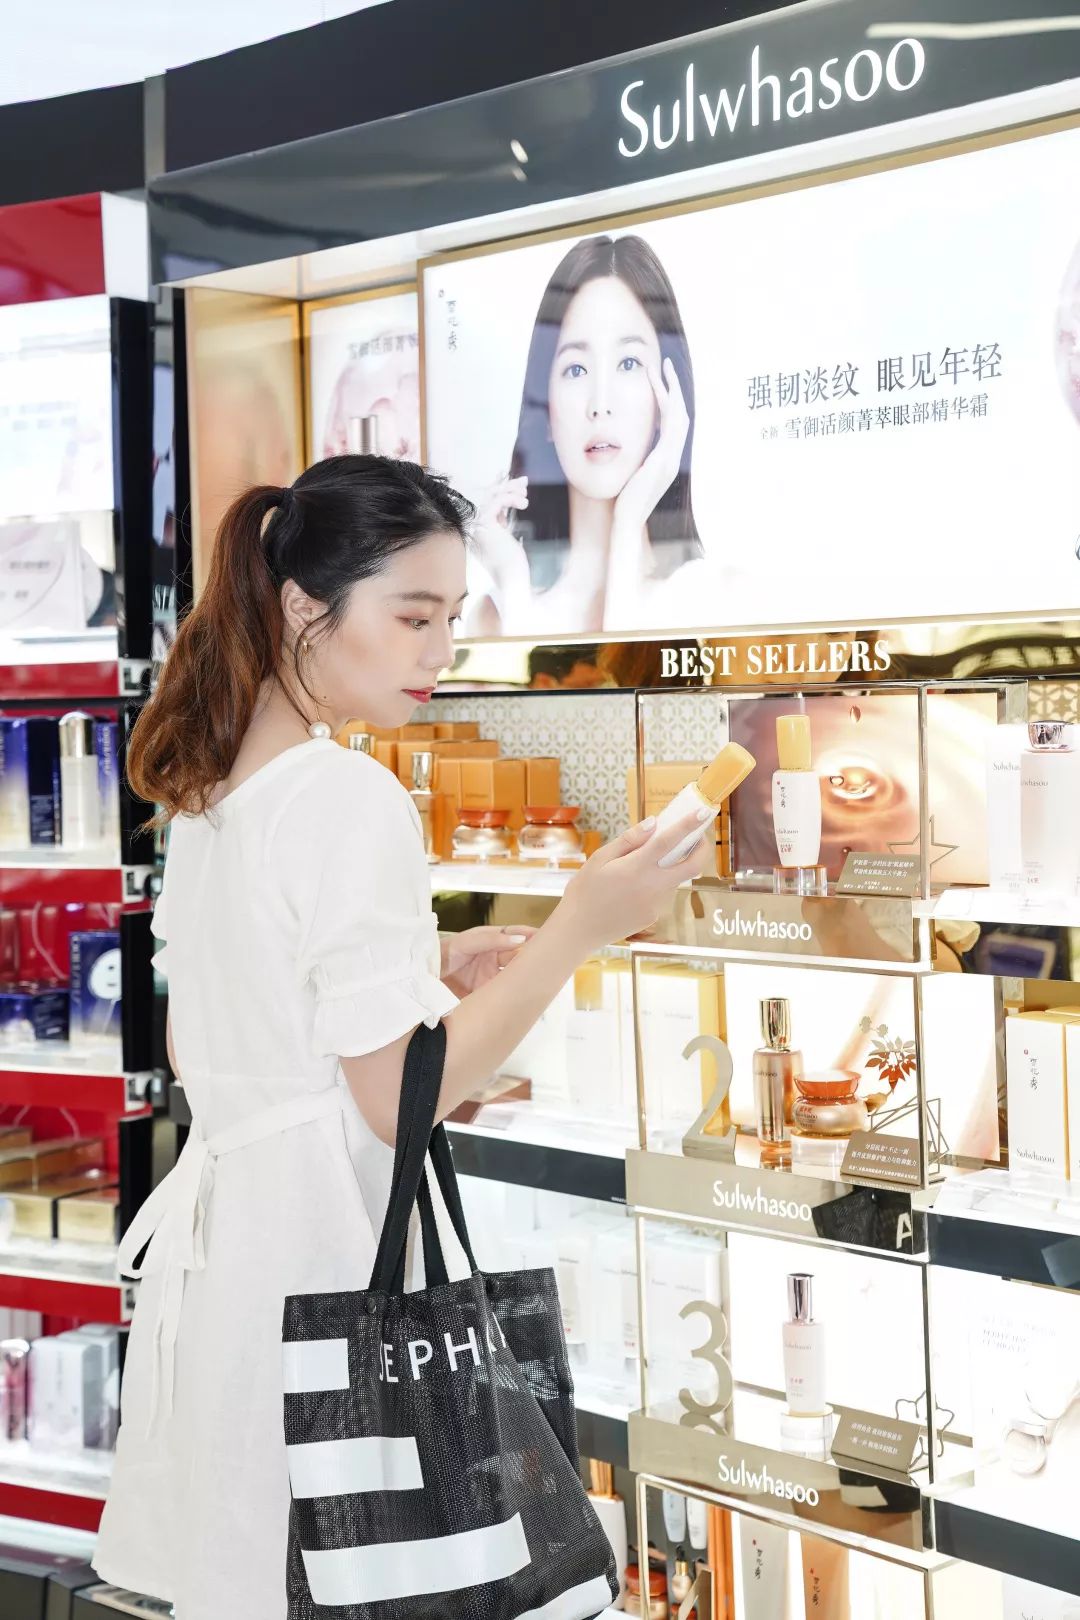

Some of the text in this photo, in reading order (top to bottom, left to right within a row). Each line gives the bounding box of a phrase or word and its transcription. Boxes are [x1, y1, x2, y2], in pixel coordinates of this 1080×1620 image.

[618, 38, 925, 158] Sulwhasoo
[746, 342, 1003, 411] 强韧淡纹 眼见年轻
[785, 392, 989, 439] 雪御活颜菁萃眼部精华霜
[661, 639, 891, 678] BEST SELLERS
[713, 908, 812, 941] Sulwhasoo
[682, 1035, 736, 1150] 2
[713, 1180, 812, 1221] Sulwhasoo
[678, 1300, 733, 1416] 3
[718, 1455, 819, 1506] Sulwhasoo
